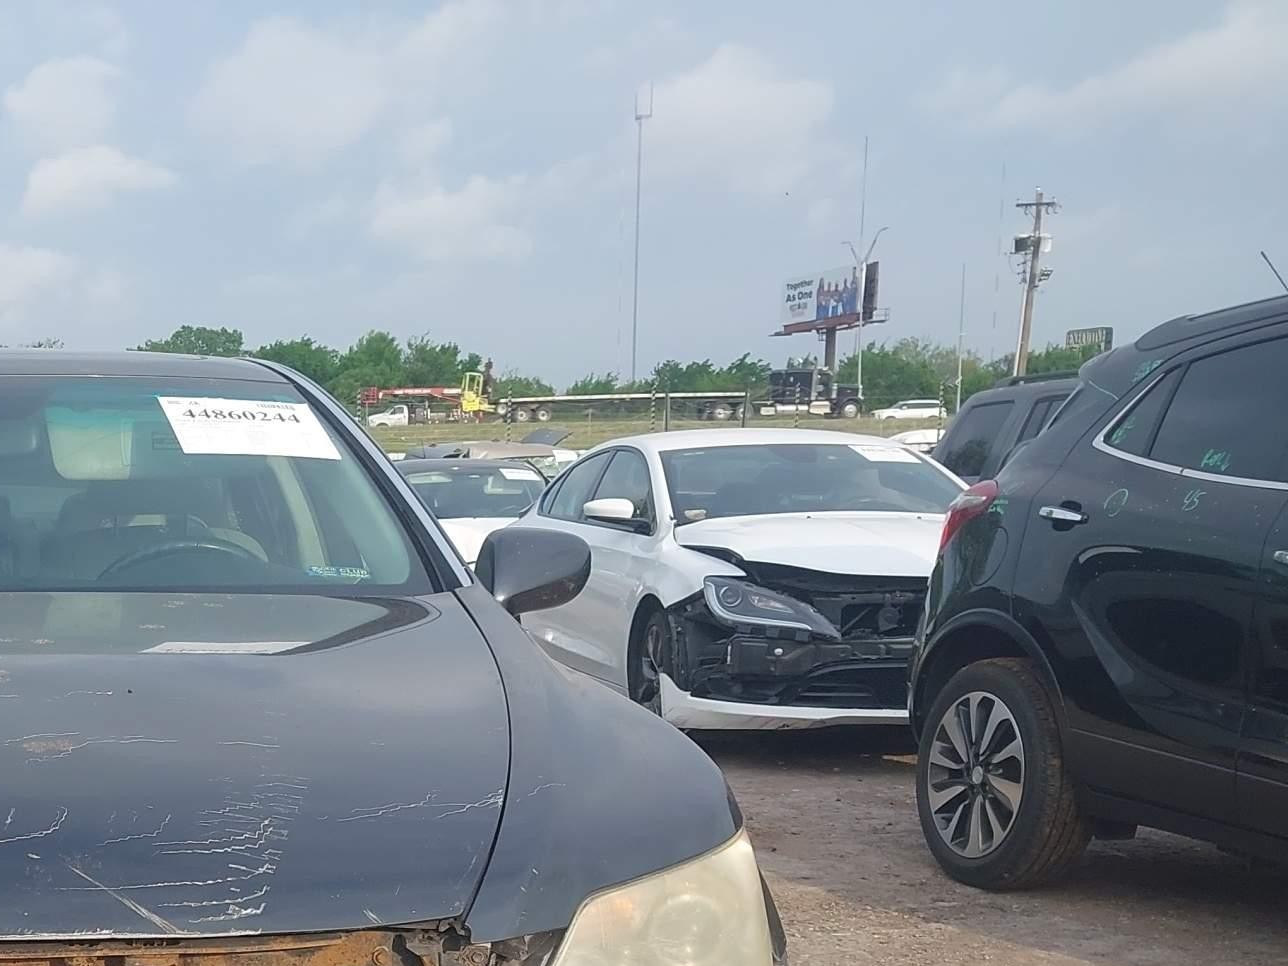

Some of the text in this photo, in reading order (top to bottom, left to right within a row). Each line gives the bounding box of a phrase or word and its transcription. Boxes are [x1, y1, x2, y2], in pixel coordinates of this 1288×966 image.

[786, 291, 814, 303] As One
[182, 408, 301, 424] 44860244
